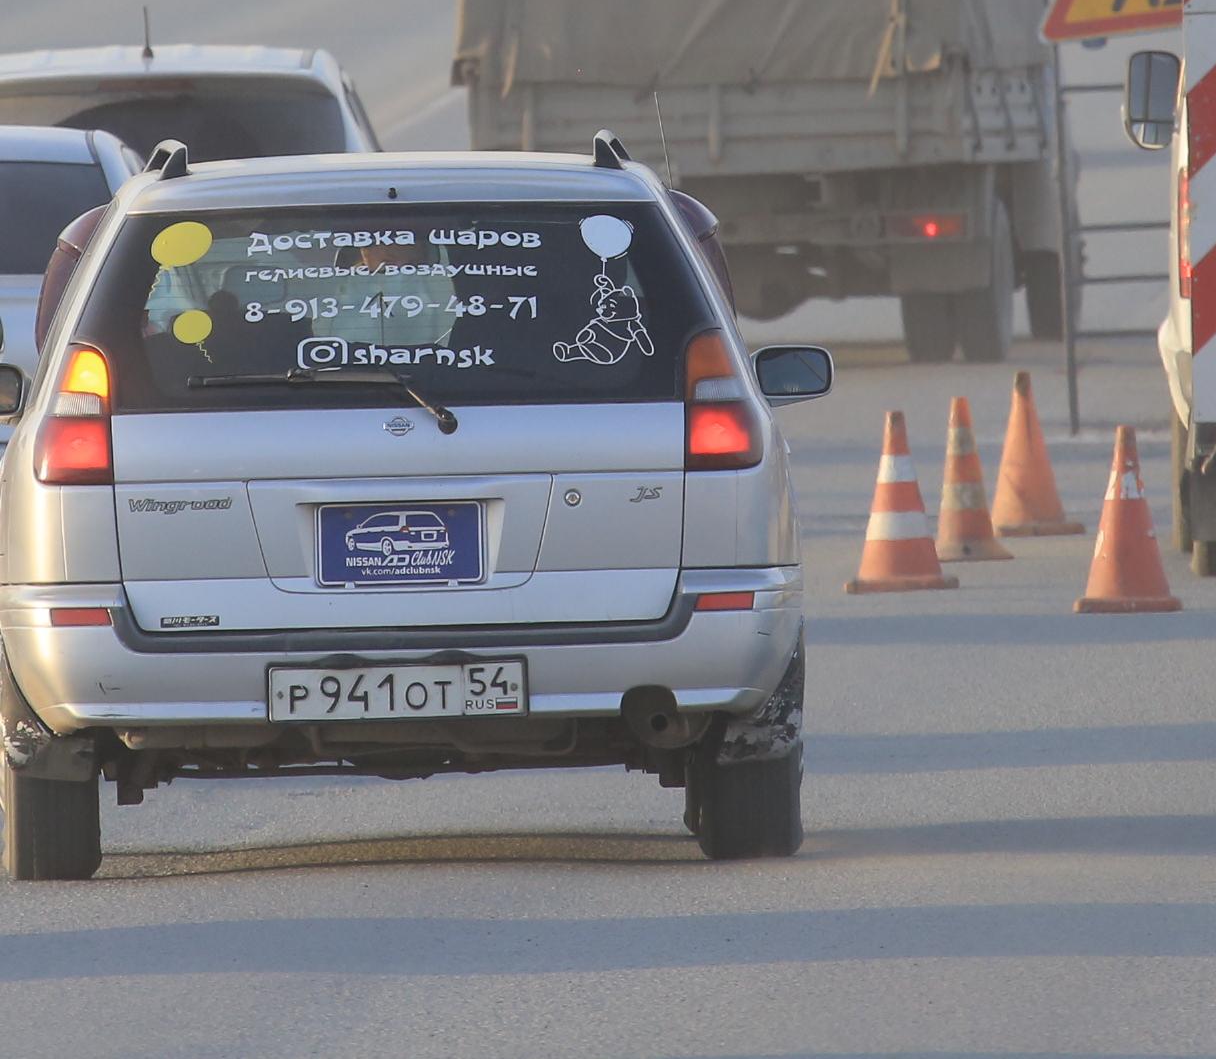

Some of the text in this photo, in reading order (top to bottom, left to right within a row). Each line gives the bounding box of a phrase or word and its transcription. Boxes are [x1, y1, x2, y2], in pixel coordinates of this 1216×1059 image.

[247, 228, 542, 257] Доставка шаров
[244, 295, 538, 323] 8-913-479-48-71
[128, 497, 233, 515] Wingroad
[345, 556, 381, 567] NISSAN
[361, 566, 441, 576] vk.com/adclubnsk
[469, 667, 508, 696] 54
[465, 699, 495, 711] RUS
